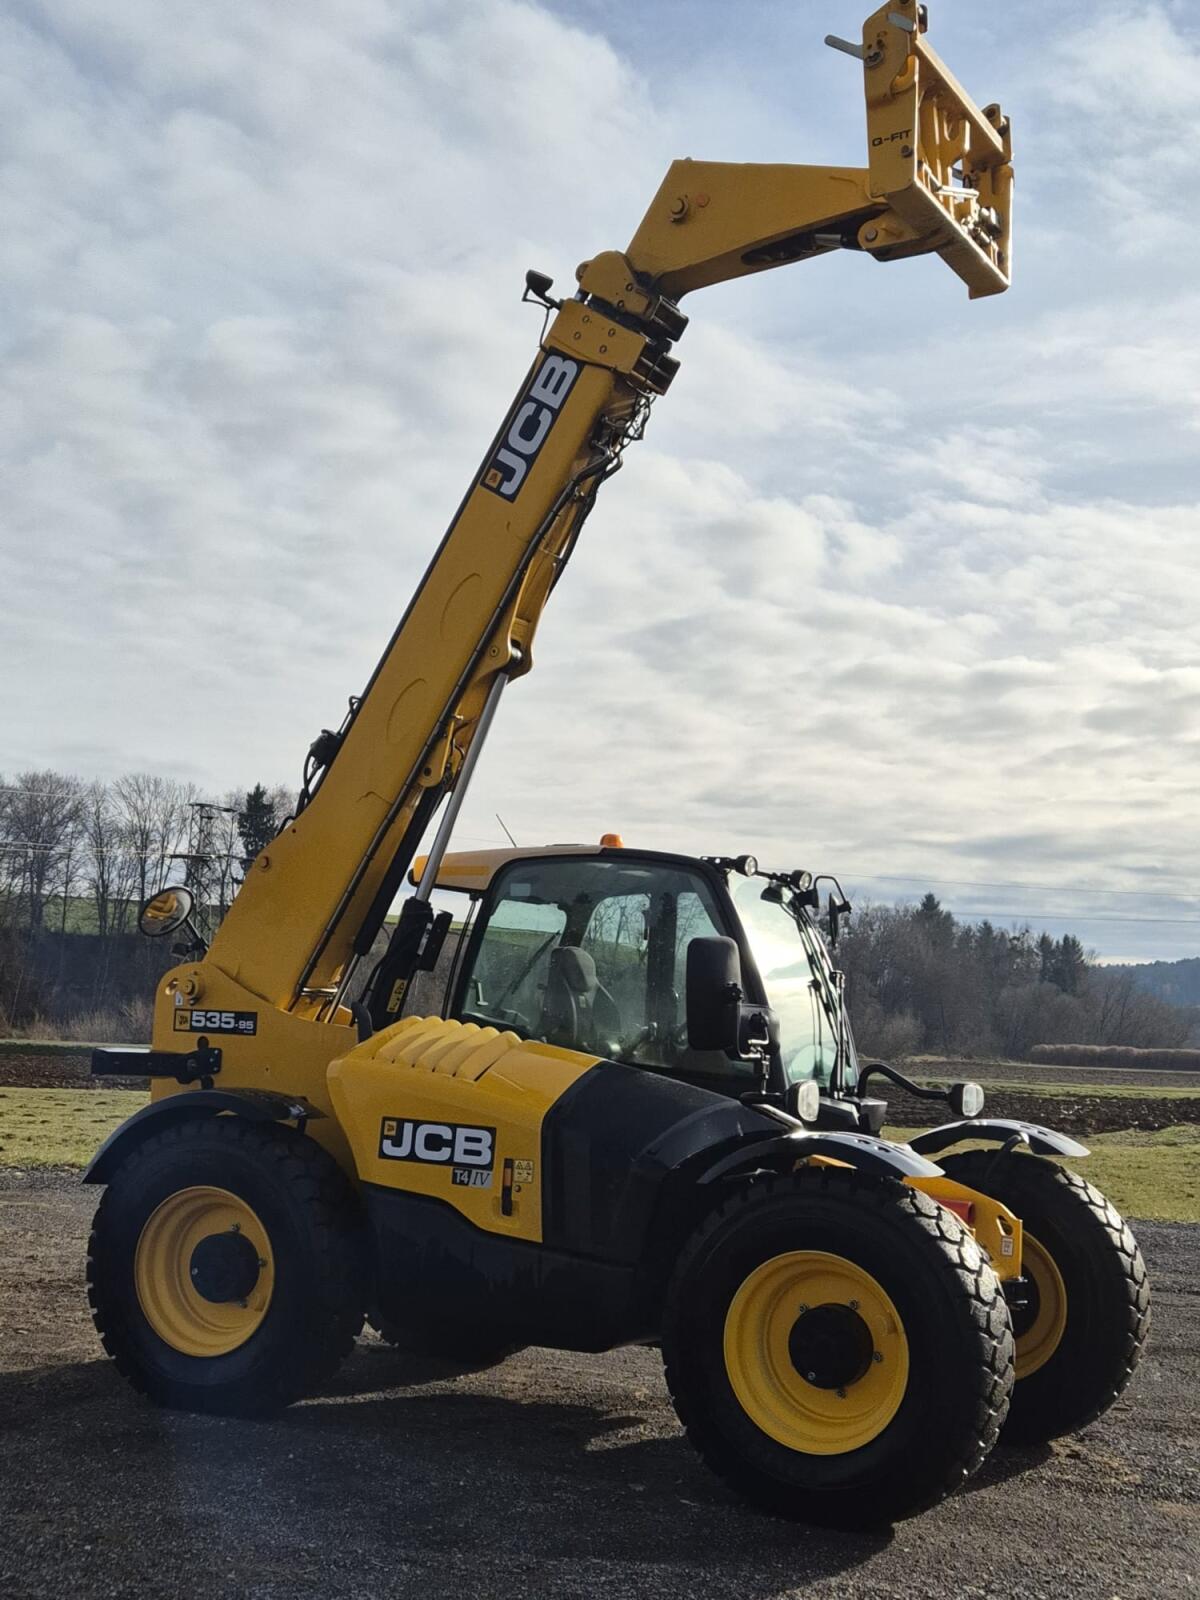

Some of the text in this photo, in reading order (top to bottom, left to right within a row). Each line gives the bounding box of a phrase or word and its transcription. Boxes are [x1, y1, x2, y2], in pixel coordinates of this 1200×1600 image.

[872, 128, 912, 147] Q-FIT
[496, 354, 578, 496] JCB
[382, 1122, 492, 1166] JCB
[454, 1169, 470, 1185] T4
